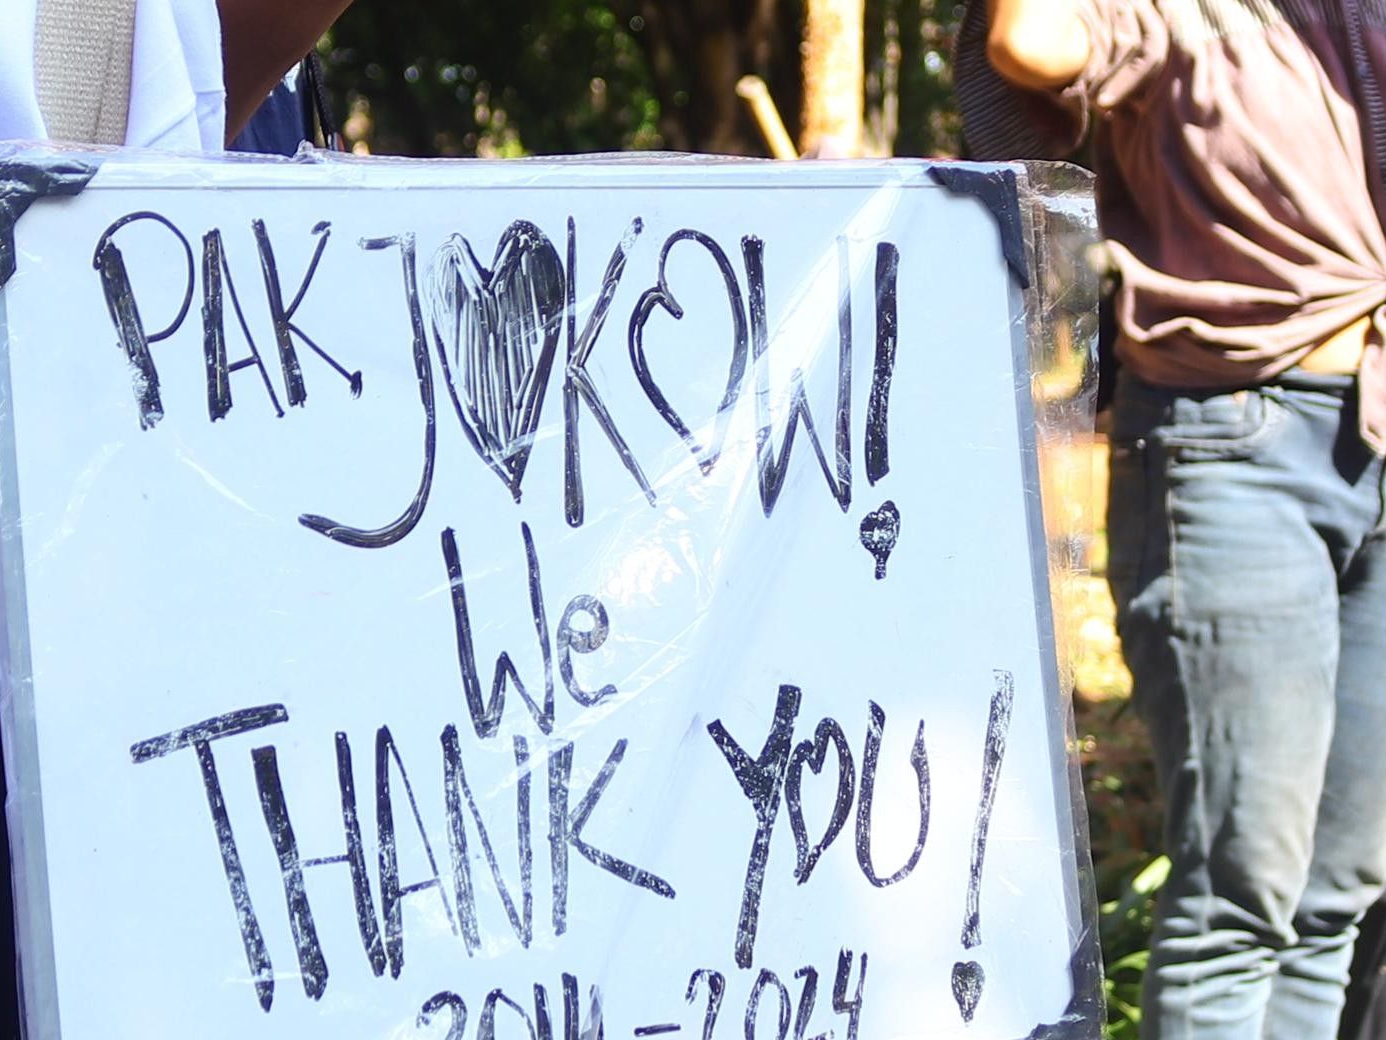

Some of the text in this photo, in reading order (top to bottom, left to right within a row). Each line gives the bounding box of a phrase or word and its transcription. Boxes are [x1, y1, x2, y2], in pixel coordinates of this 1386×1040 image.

[92, 210, 363, 431] PAK
[442, 521, 618, 738] We
[130, 703, 676, 1014] THANK
